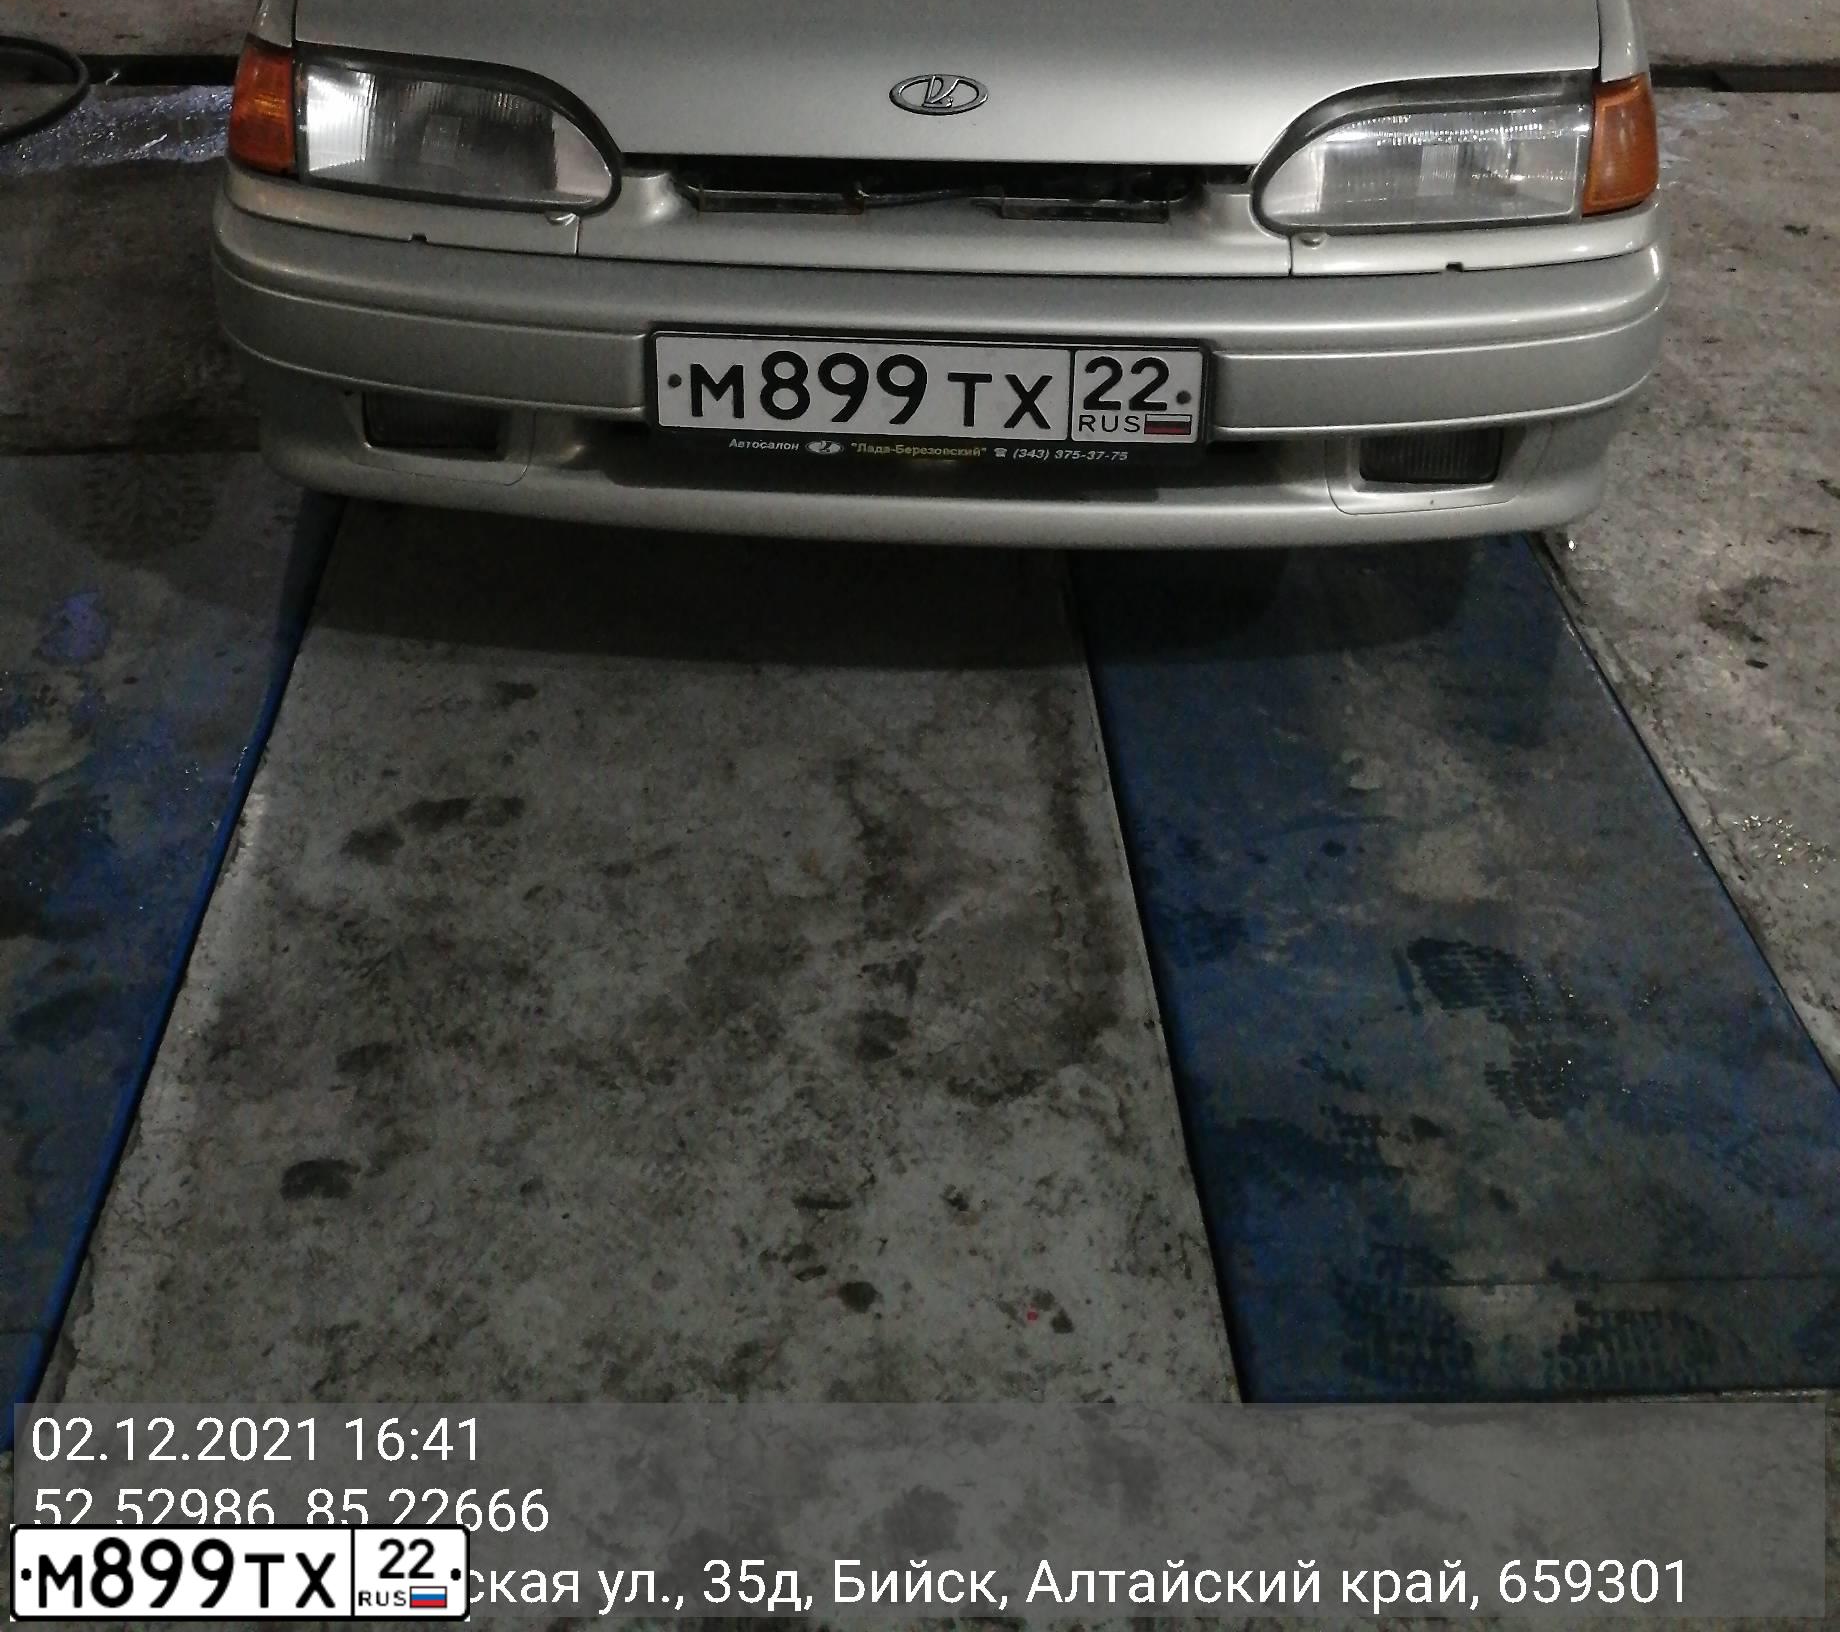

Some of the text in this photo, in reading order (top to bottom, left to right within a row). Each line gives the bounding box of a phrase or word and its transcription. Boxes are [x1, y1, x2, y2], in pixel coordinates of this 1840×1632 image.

[1083, 356, 1170, 411] 22
[1079, 415, 1141, 433] RUS
[728, 438, 799, 451] Автосалон
[1012, 448, 1049, 461] (343)
[1054, 449, 1129, 461] 375-37-75
